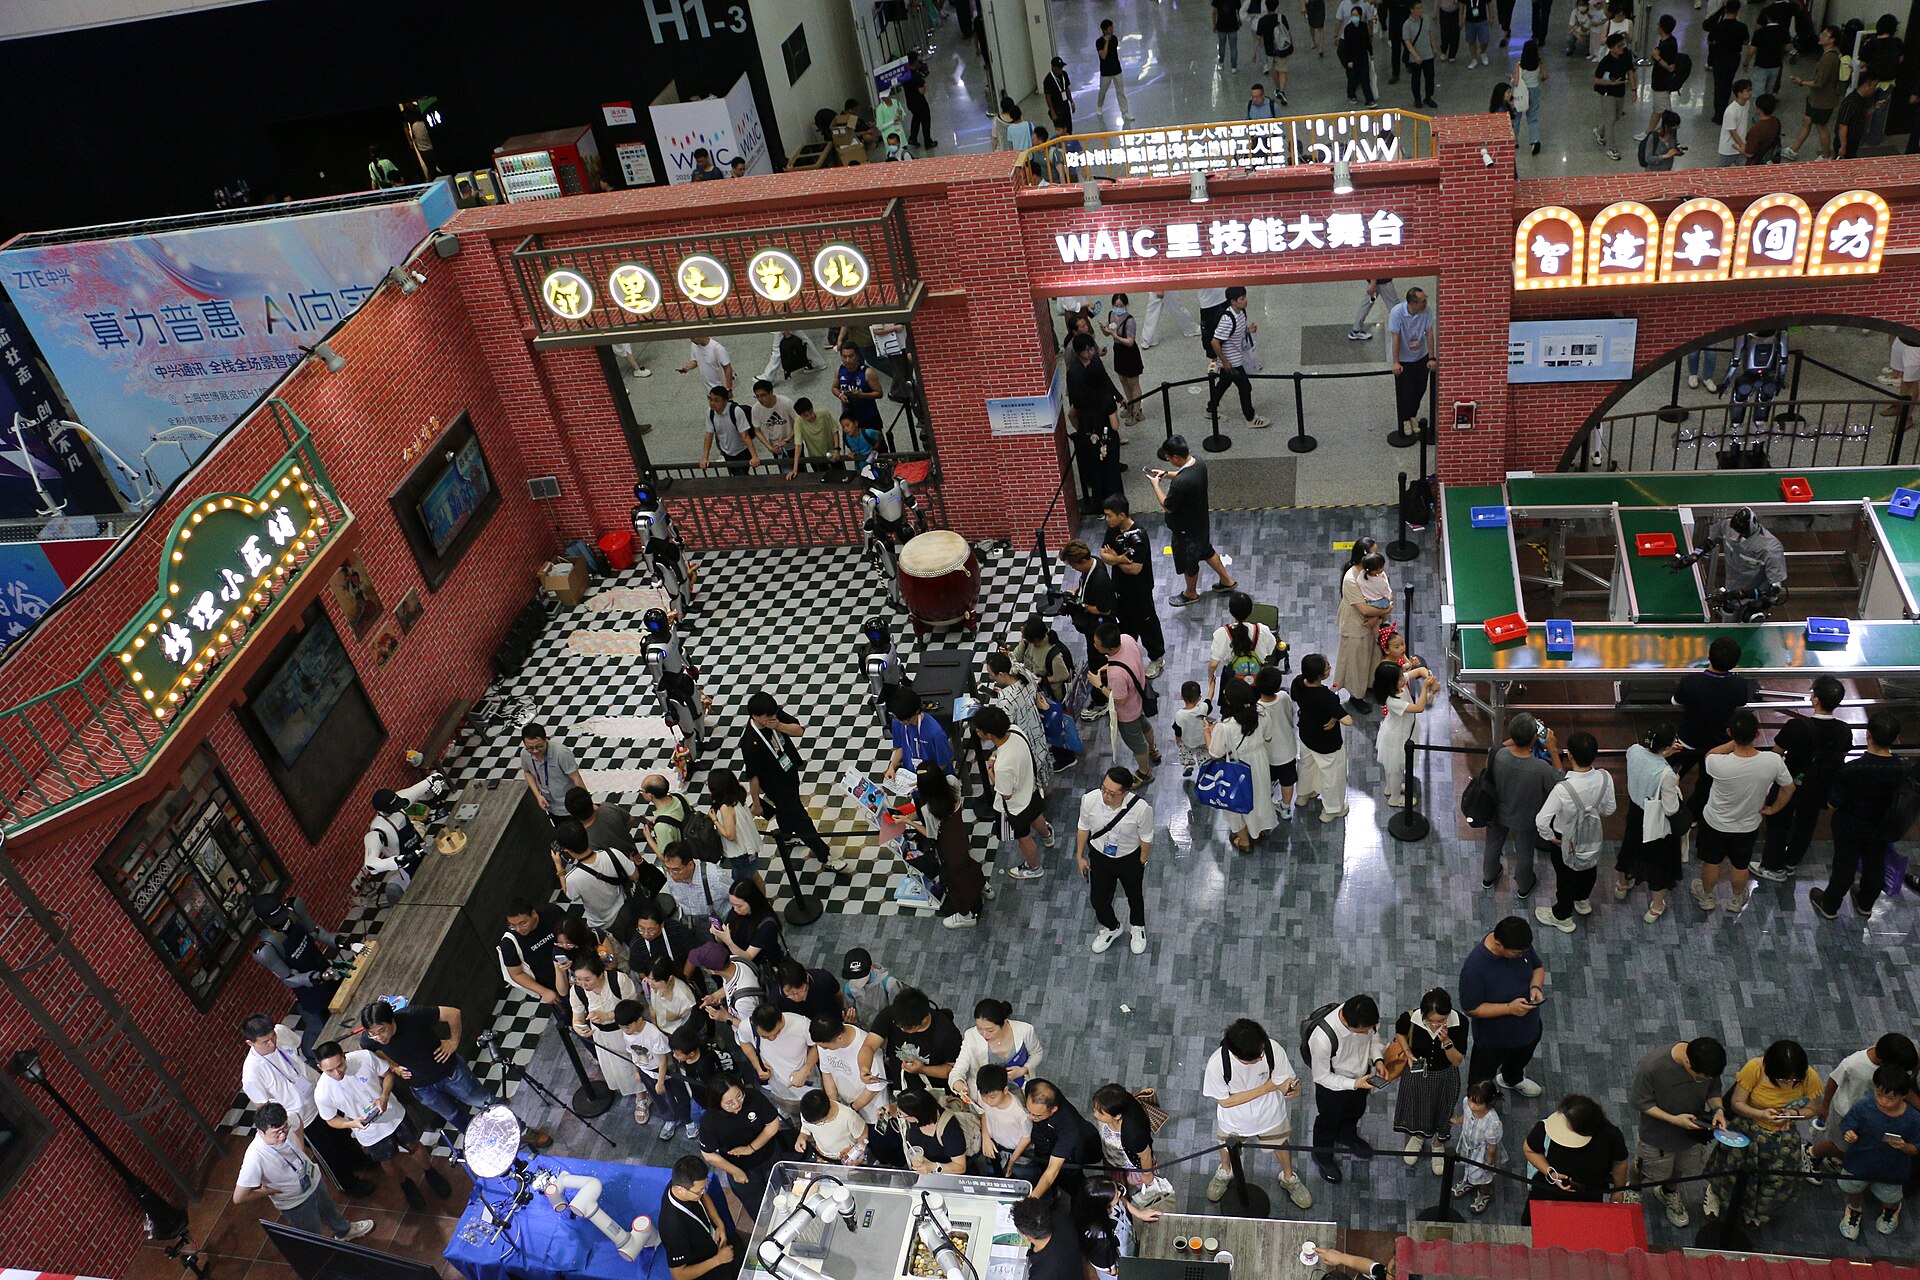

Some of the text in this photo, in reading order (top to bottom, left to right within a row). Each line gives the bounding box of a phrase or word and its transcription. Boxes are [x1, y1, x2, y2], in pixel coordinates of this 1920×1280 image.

[643, 0, 747, 44] H1-3
[670, 148, 733, 171] WIC
[740, 122, 762, 157] WAIC
[1055, 229, 1160, 263] WAIC
[1209, 209, 1406, 256] 技能大舞台
[1530, 217, 1874, 274] 智造车间坊
[549, 254, 861, 315] 邻里文艺站
[84, 299, 246, 349] 算力普惠
[154, 352, 308, 380] 中兴通讯 全栈全场景智算
